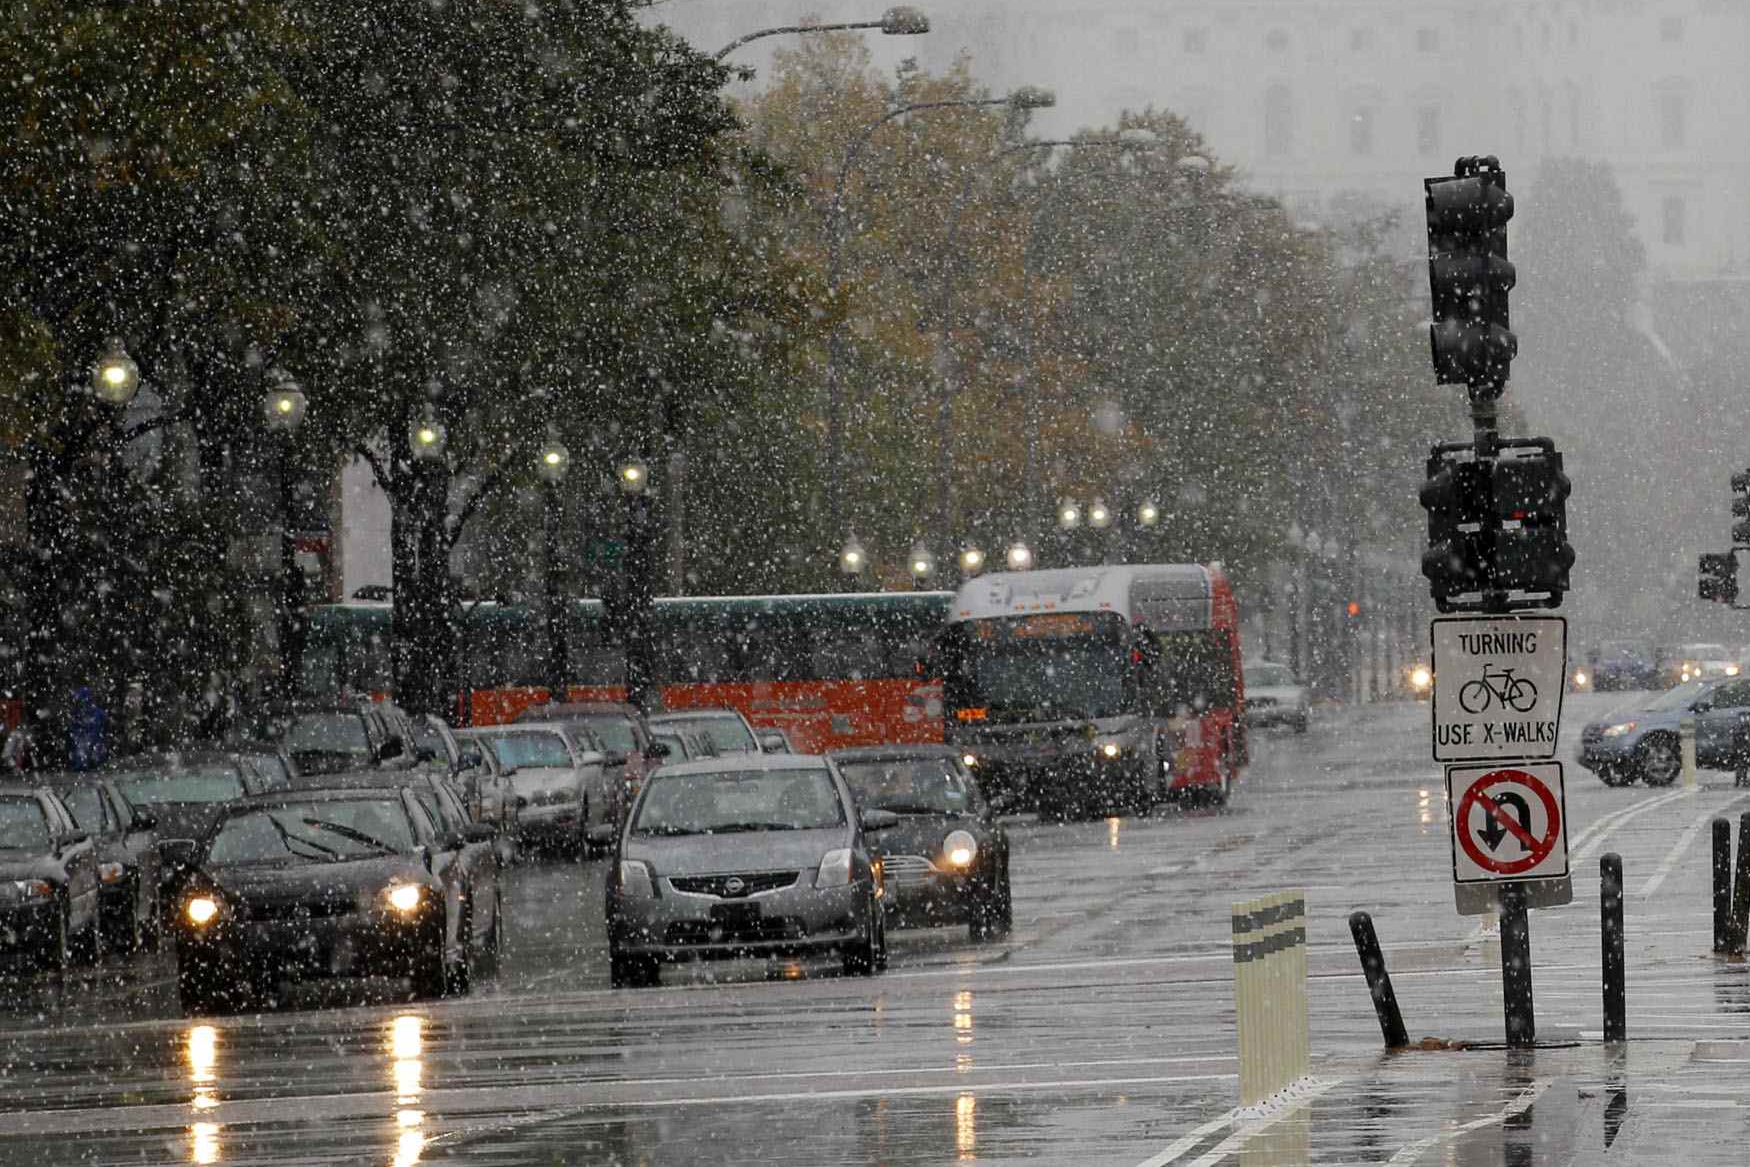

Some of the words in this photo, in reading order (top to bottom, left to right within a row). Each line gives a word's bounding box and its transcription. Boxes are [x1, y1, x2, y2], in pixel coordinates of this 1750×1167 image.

[1458, 632, 1537, 655] TURNING
[1438, 723, 1473, 745] USE
[1483, 720, 1555, 744] X-WALKS
